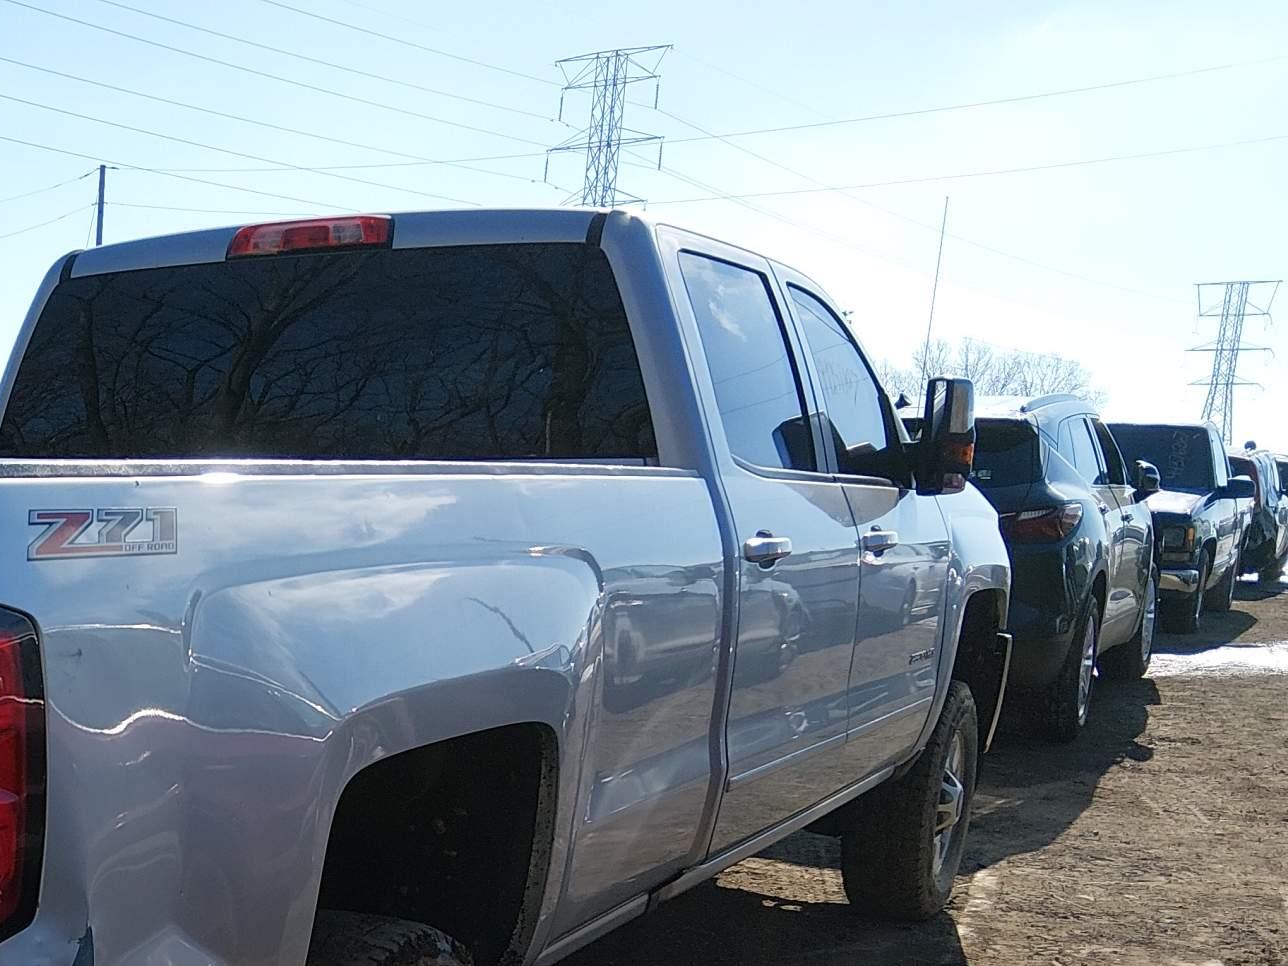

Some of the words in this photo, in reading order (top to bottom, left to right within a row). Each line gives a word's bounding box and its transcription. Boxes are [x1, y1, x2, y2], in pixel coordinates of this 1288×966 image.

[27, 508, 178, 562] Z71
[124, 543, 145, 553] OFF
[146, 542, 175, 552] ROAD
